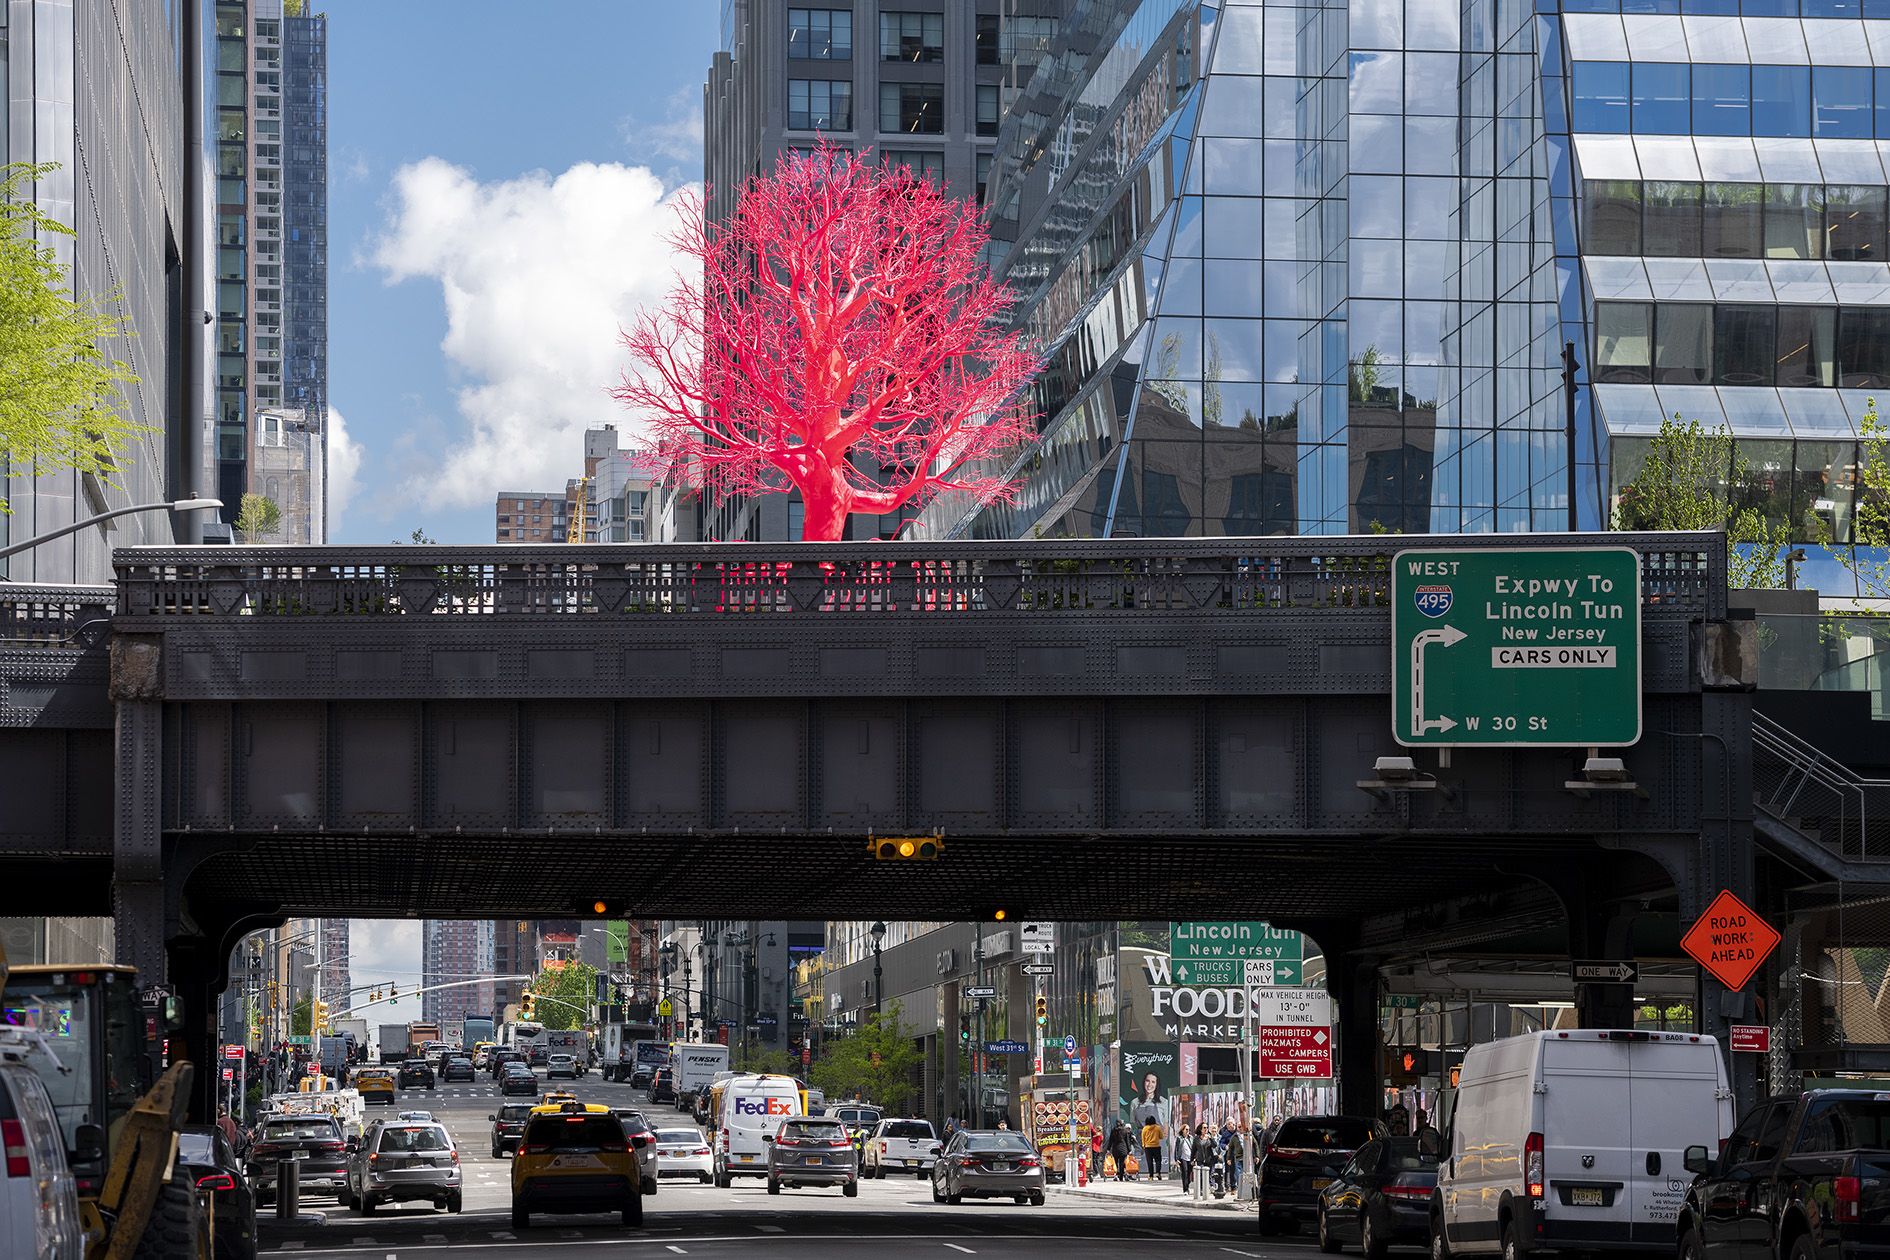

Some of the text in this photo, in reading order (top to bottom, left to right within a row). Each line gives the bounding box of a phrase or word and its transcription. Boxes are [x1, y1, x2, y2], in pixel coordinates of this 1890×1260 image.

[1408, 562, 1460, 576] WEST
[1495, 575, 1613, 598] Expwy To
[1418, 594, 1449, 609] 495
[1486, 601, 1623, 619] Lincoln Tun
[1502, 626, 1606, 643] New Jersey
[1500, 650, 1609, 664] CARS ONLY
[1465, 716, 1548, 731] W 30 St
[1710, 916, 1747, 930] ROAD
[1177, 923, 1295, 939] Lincoln Tun
[1190, 944, 1283, 959] New Jersey
[1711, 948, 1755, 962] AHEAD
[1194, 962, 1232, 972] TRUCKS
[1246, 962, 1272, 972] CARS
[1581, 967, 1628, 977] ONE WAY
[1197, 974, 1229, 983] BUSES
[1246, 975, 1272, 984] ONLY
[1276, 992, 1303, 1000] VEHICLE
[1306, 992, 1329, 1000] HEIGH
[1396, 997, 1408, 1007] 30
[1165, 1024, 1242, 1037] MARKE
[1262, 1028, 1312, 1037] PROHIBITED
[549, 1037, 578, 1047] FedEx
[1262, 1039, 1302, 1047] HAZMATS
[1018, 1044, 1025, 1052] St
[1262, 1049, 1276, 1057] RVs
[1289, 1049, 1329, 1058] CAMPERS
[687, 1055, 723, 1064] PENSKE
[1132, 1052, 1174, 1066] Everything
[1275, 1064, 1317, 1074] USE GWB
[735, 1097, 792, 1116] FedEx
